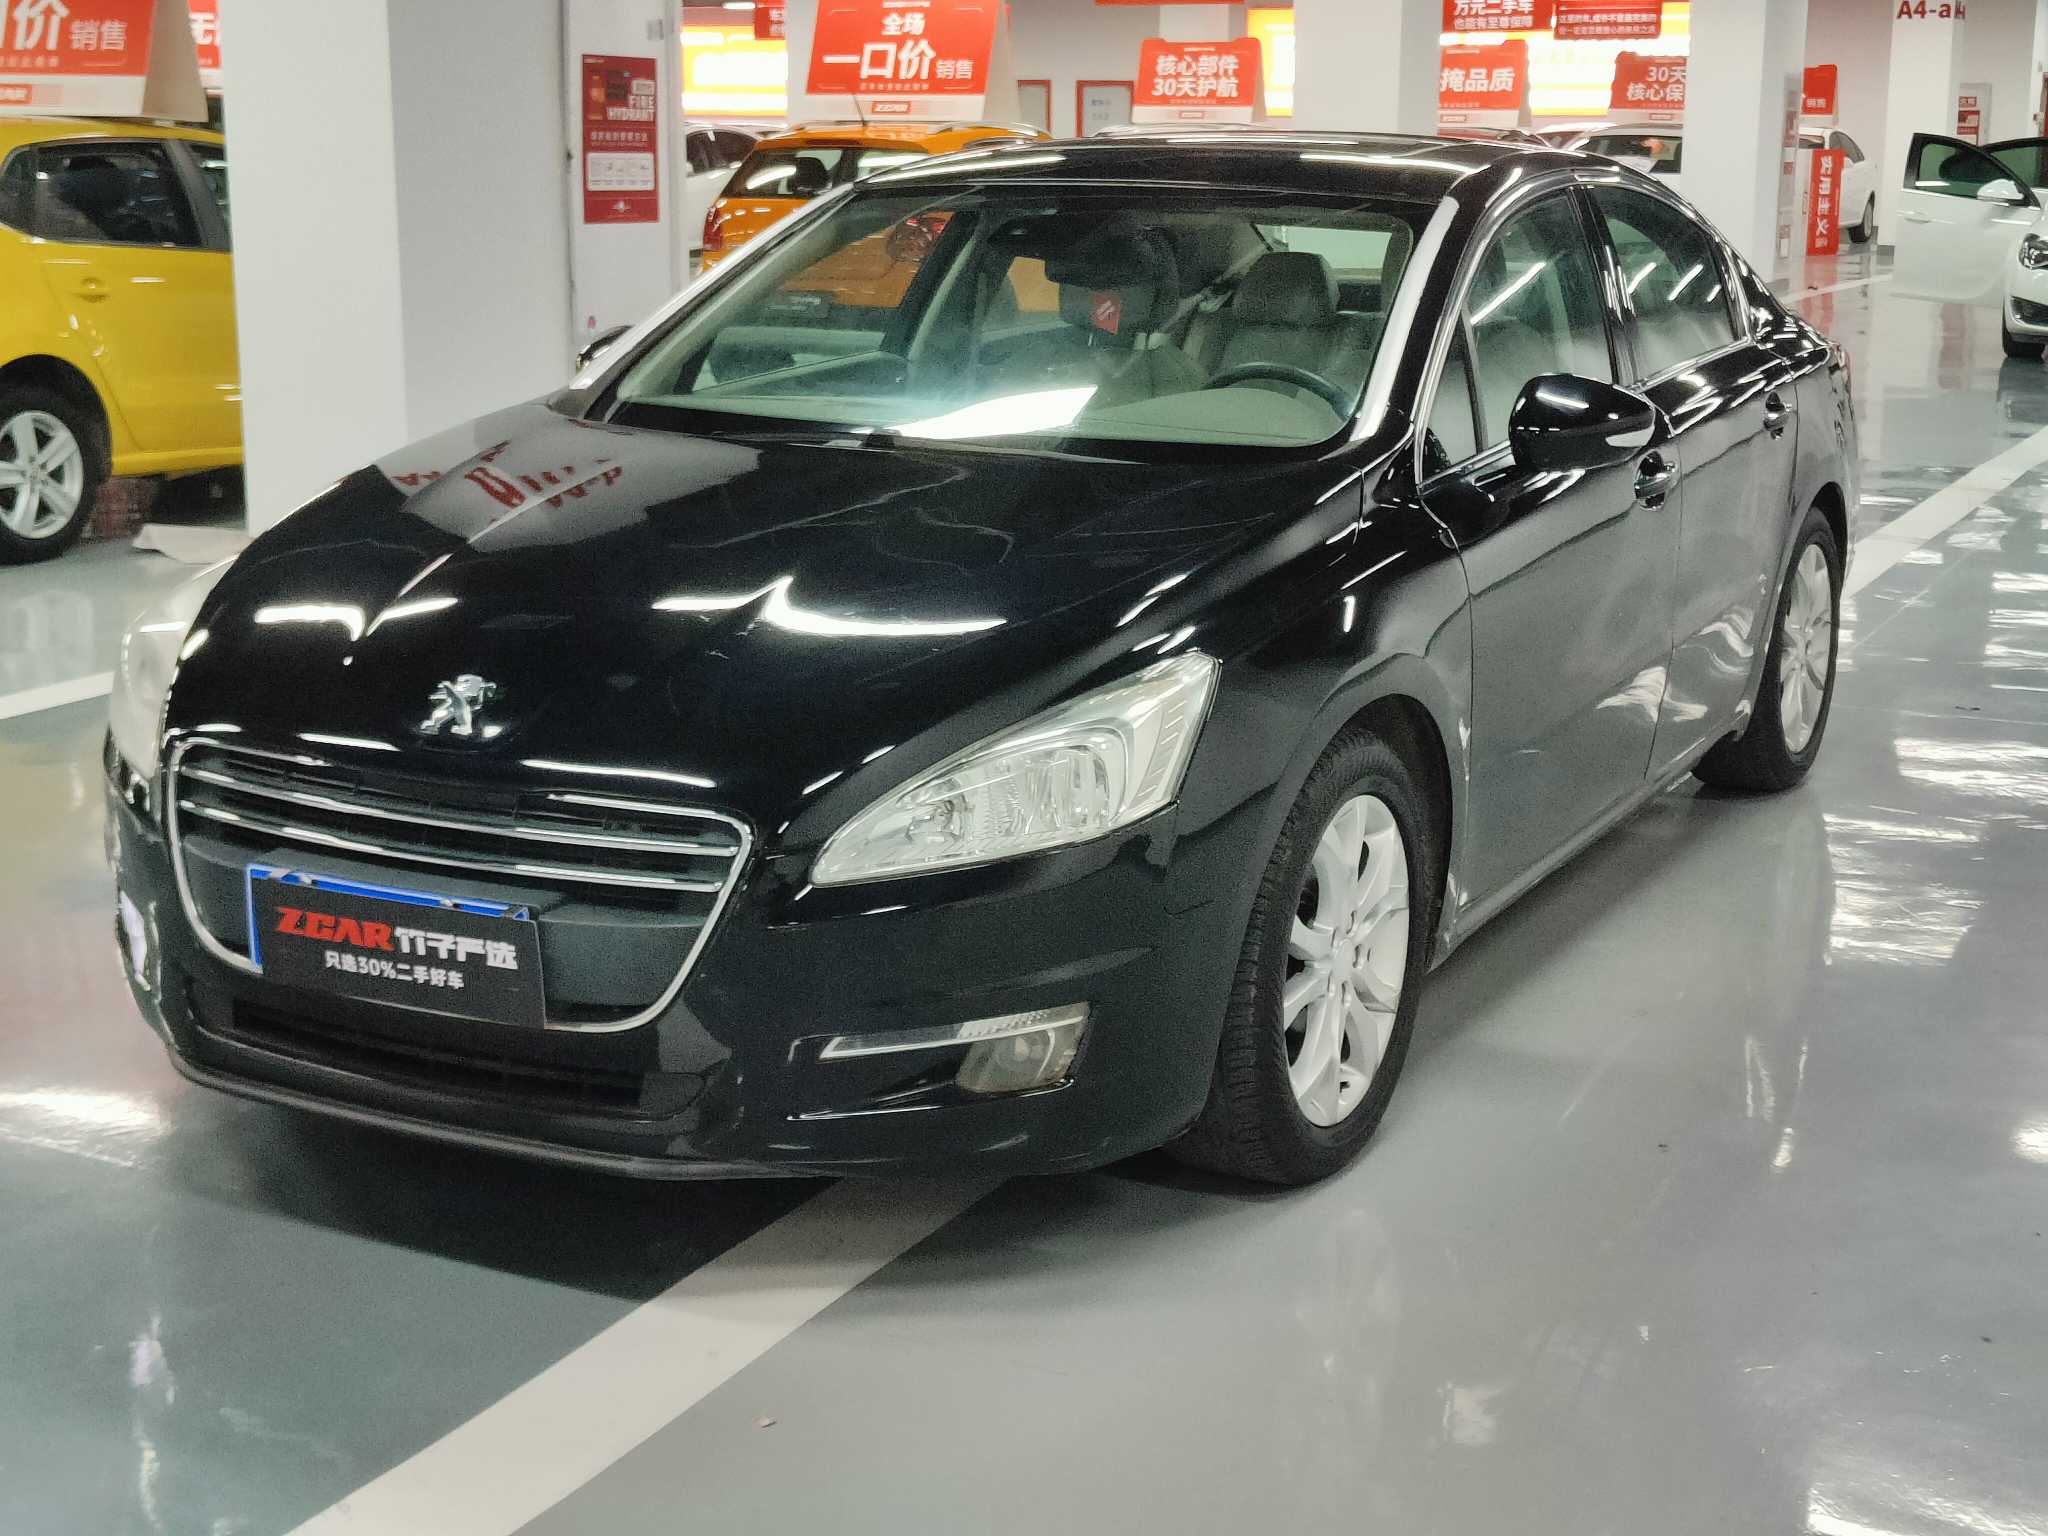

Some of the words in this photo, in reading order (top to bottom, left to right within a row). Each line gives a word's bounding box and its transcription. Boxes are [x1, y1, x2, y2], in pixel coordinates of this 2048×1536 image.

[0, 0, 69, 50] 价
[70, 19, 127, 50] 销售
[881, 12, 926, 35] 全场
[823, 39, 936, 80] 一口价
[936, 59, 974, 79] 销售
[1155, 55, 1239, 76] 核心部件
[1646, 65, 1687, 83] 30天
[1151, 77, 1239, 98] 30天护航
